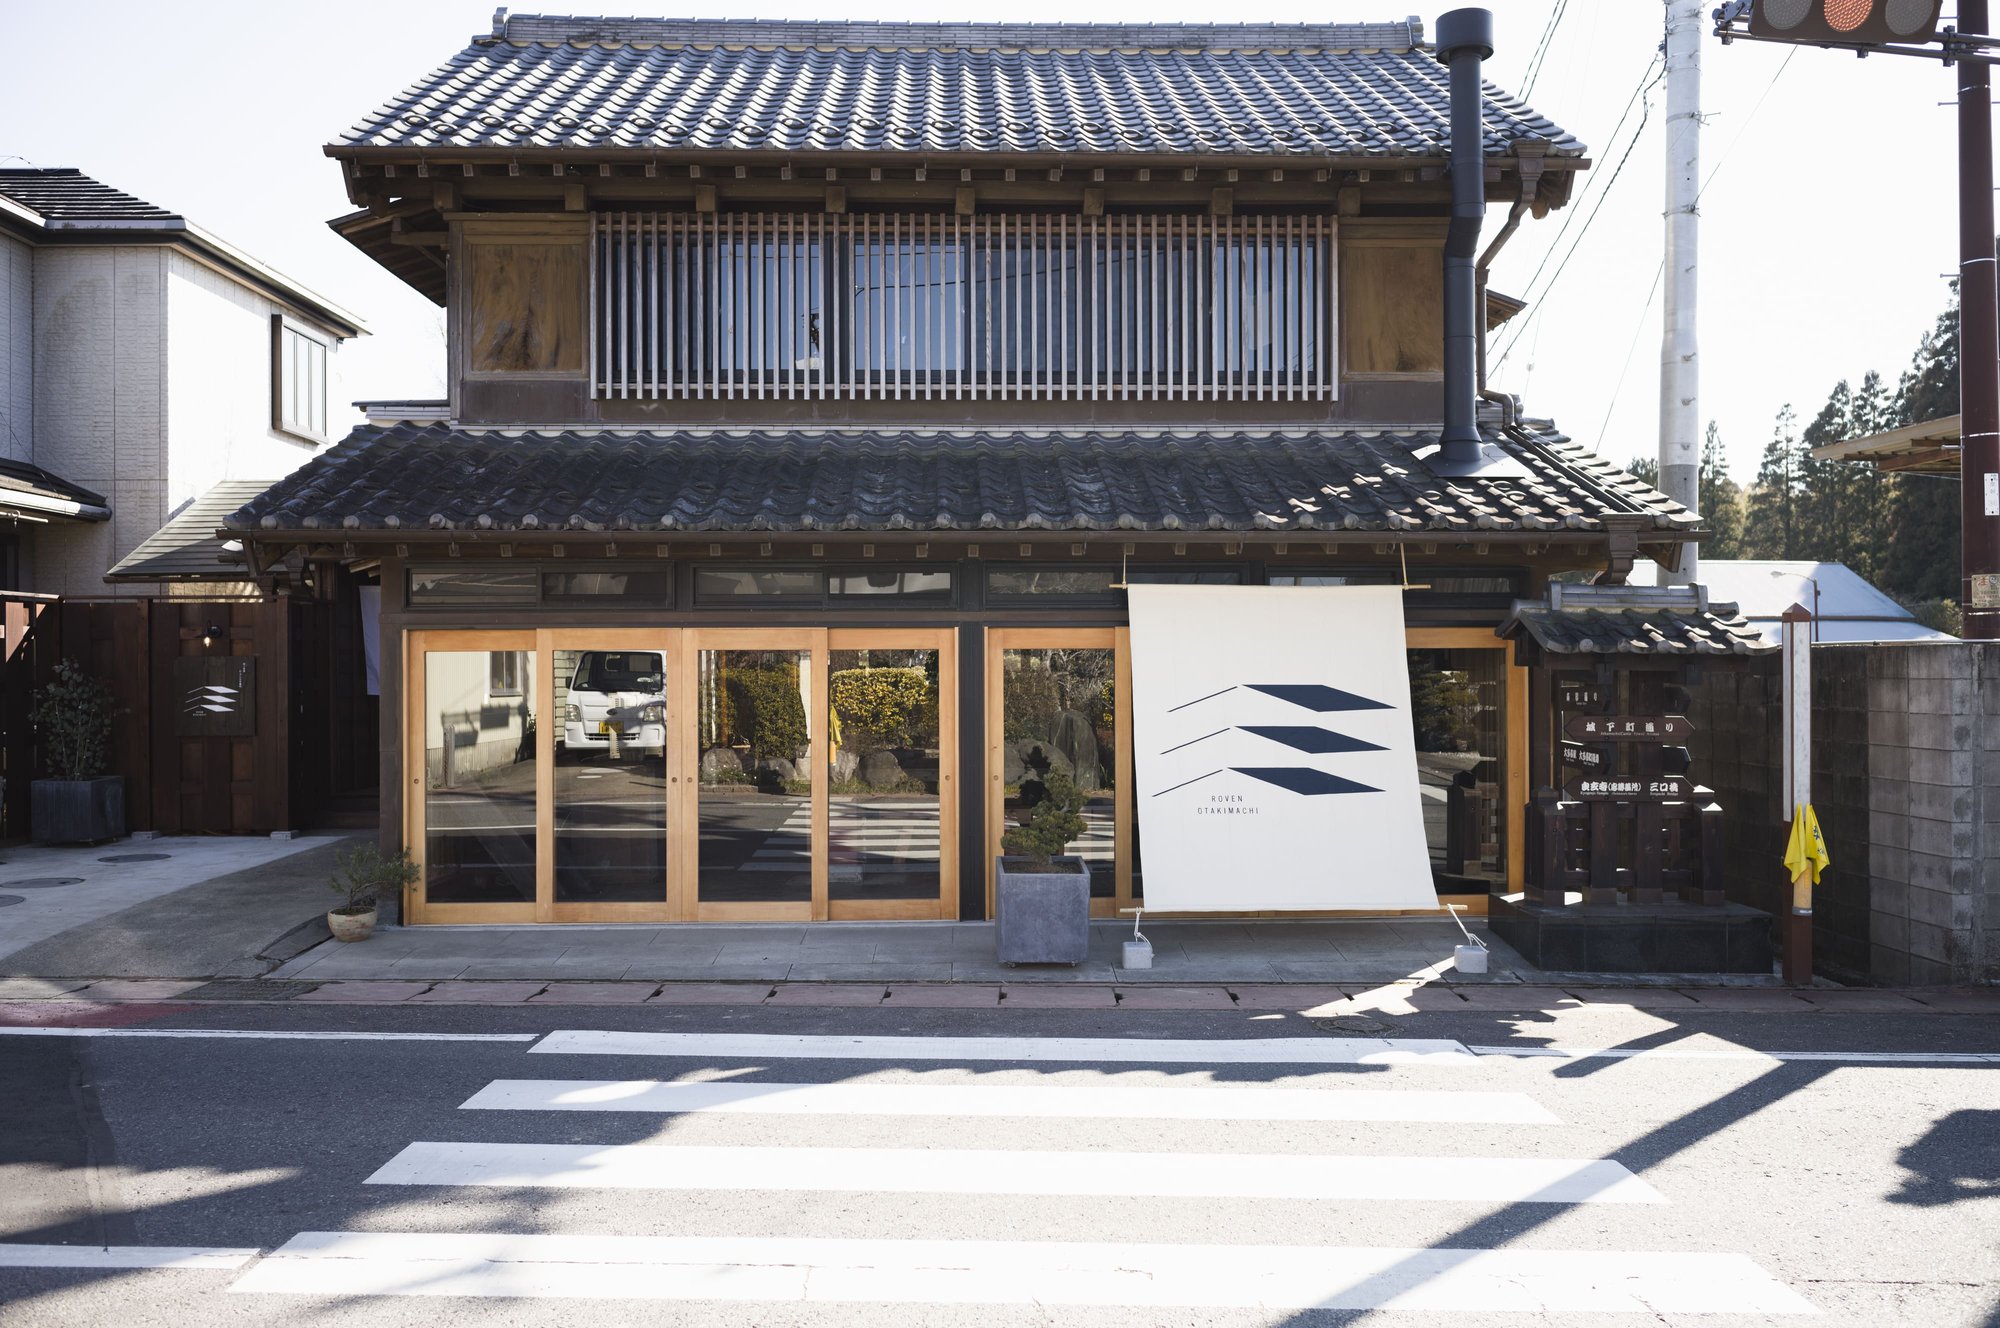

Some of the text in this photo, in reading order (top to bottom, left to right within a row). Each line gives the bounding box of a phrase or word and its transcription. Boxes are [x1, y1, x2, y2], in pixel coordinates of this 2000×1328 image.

[1585, 721, 1674, 732] 城下町通り
[1211, 795, 1243, 803] ROVEN
[1197, 807, 1259, 815] OTAKIMACHI
